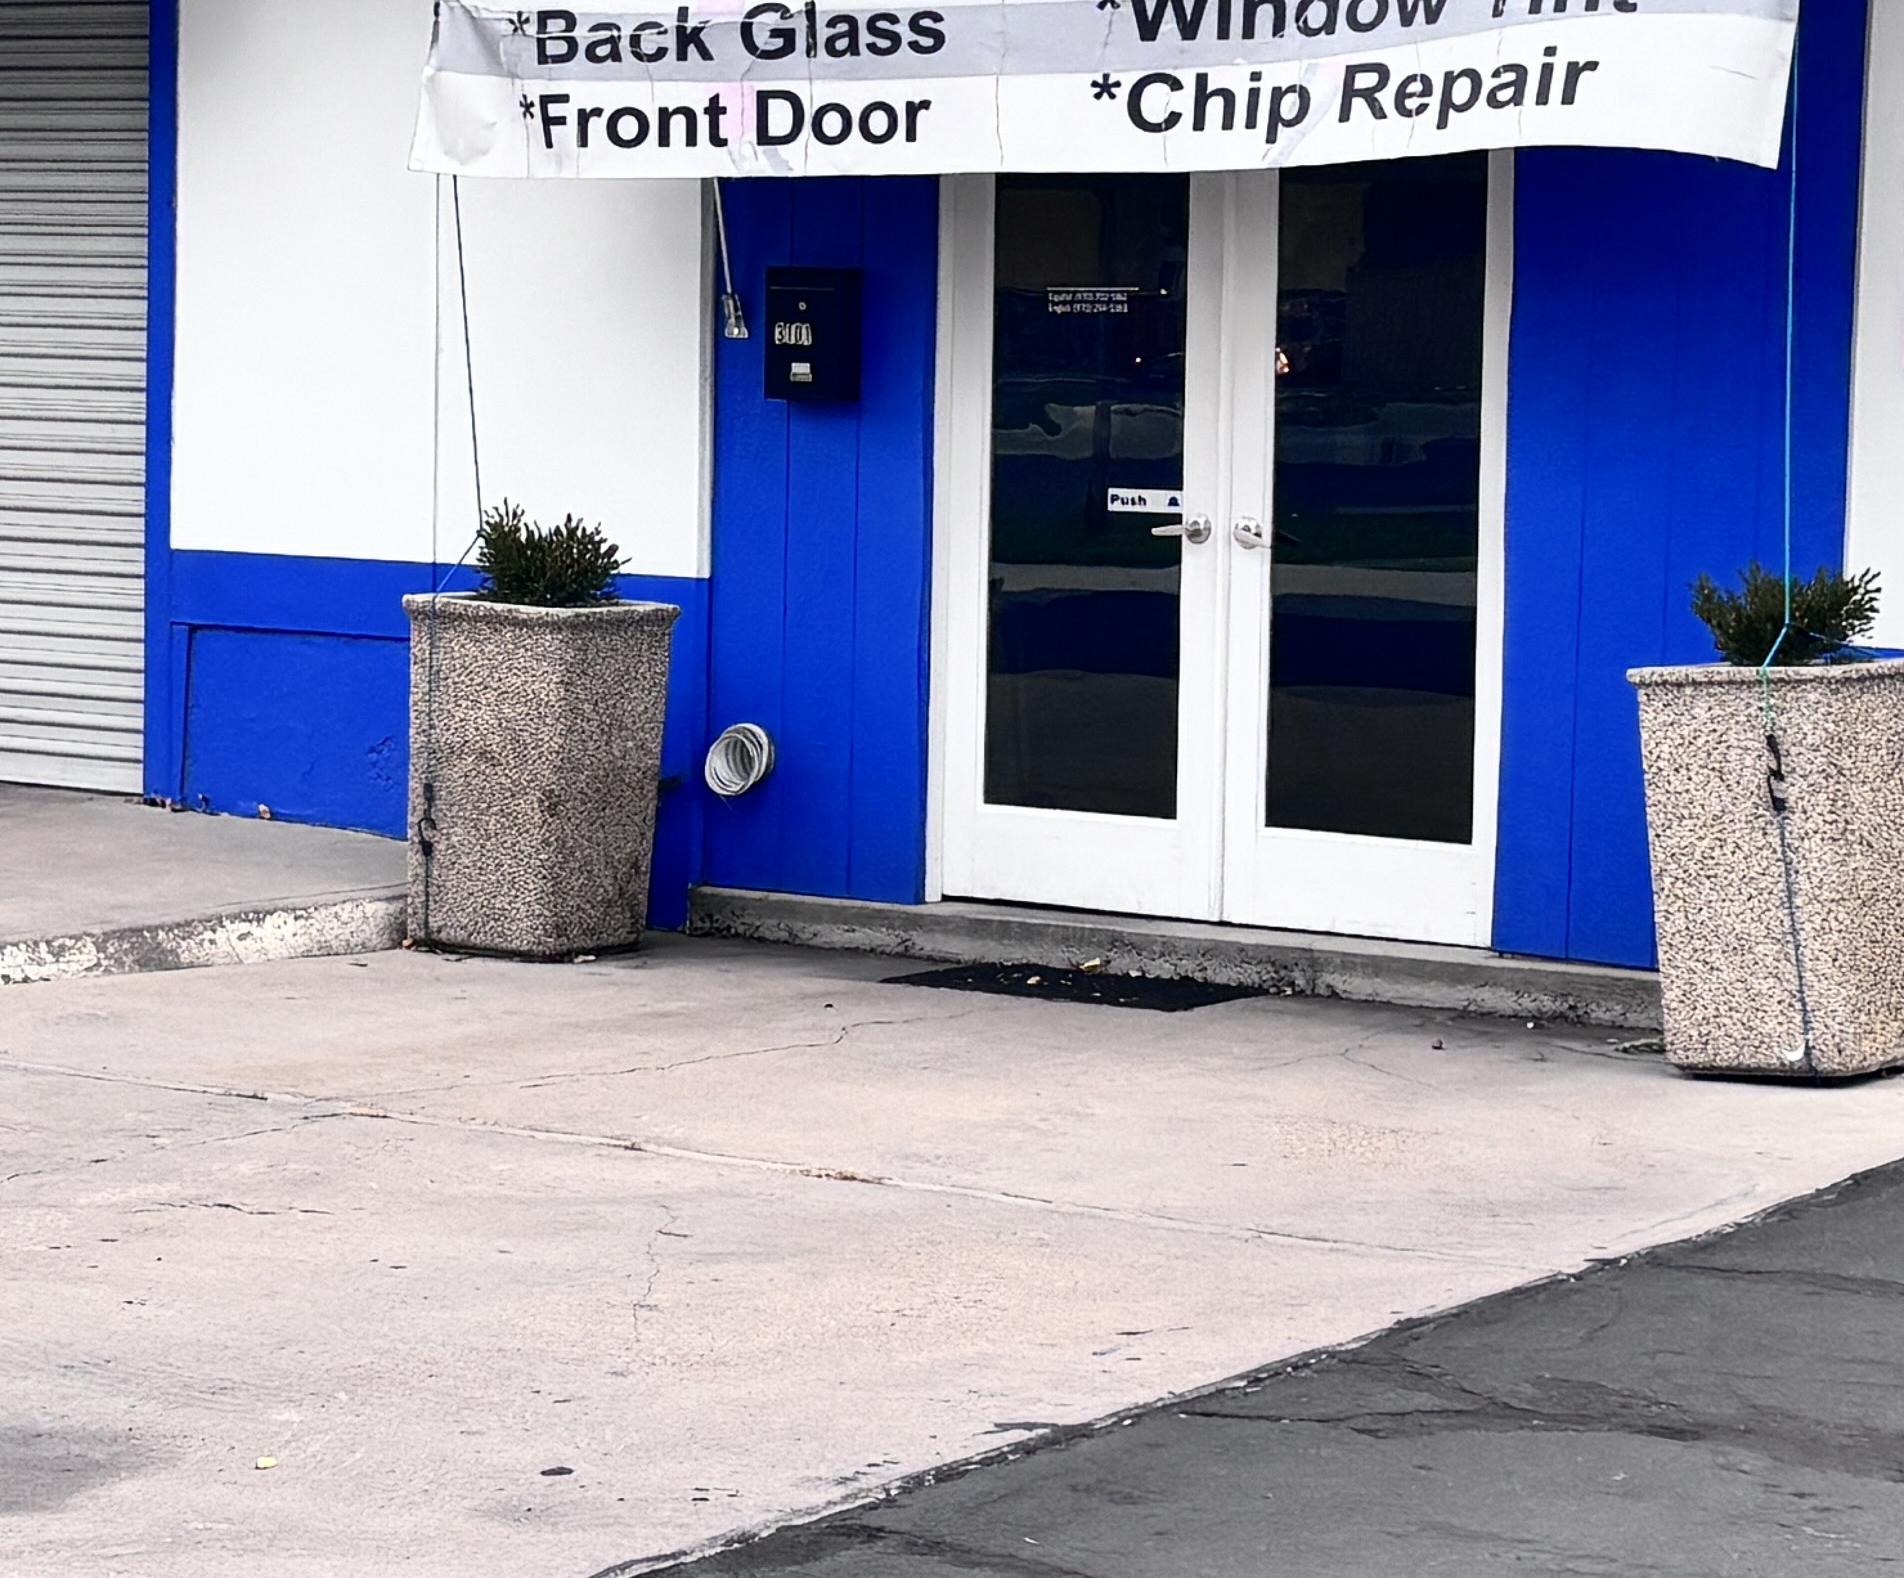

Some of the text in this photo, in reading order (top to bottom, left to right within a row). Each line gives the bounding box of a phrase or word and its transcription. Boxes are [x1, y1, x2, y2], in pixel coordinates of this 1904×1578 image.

[740, 0, 947, 61] Glass
[1337, 46, 1600, 130] Repair
[755, 89, 932, 148] Door
[1110, 493, 1147, 506] Push
